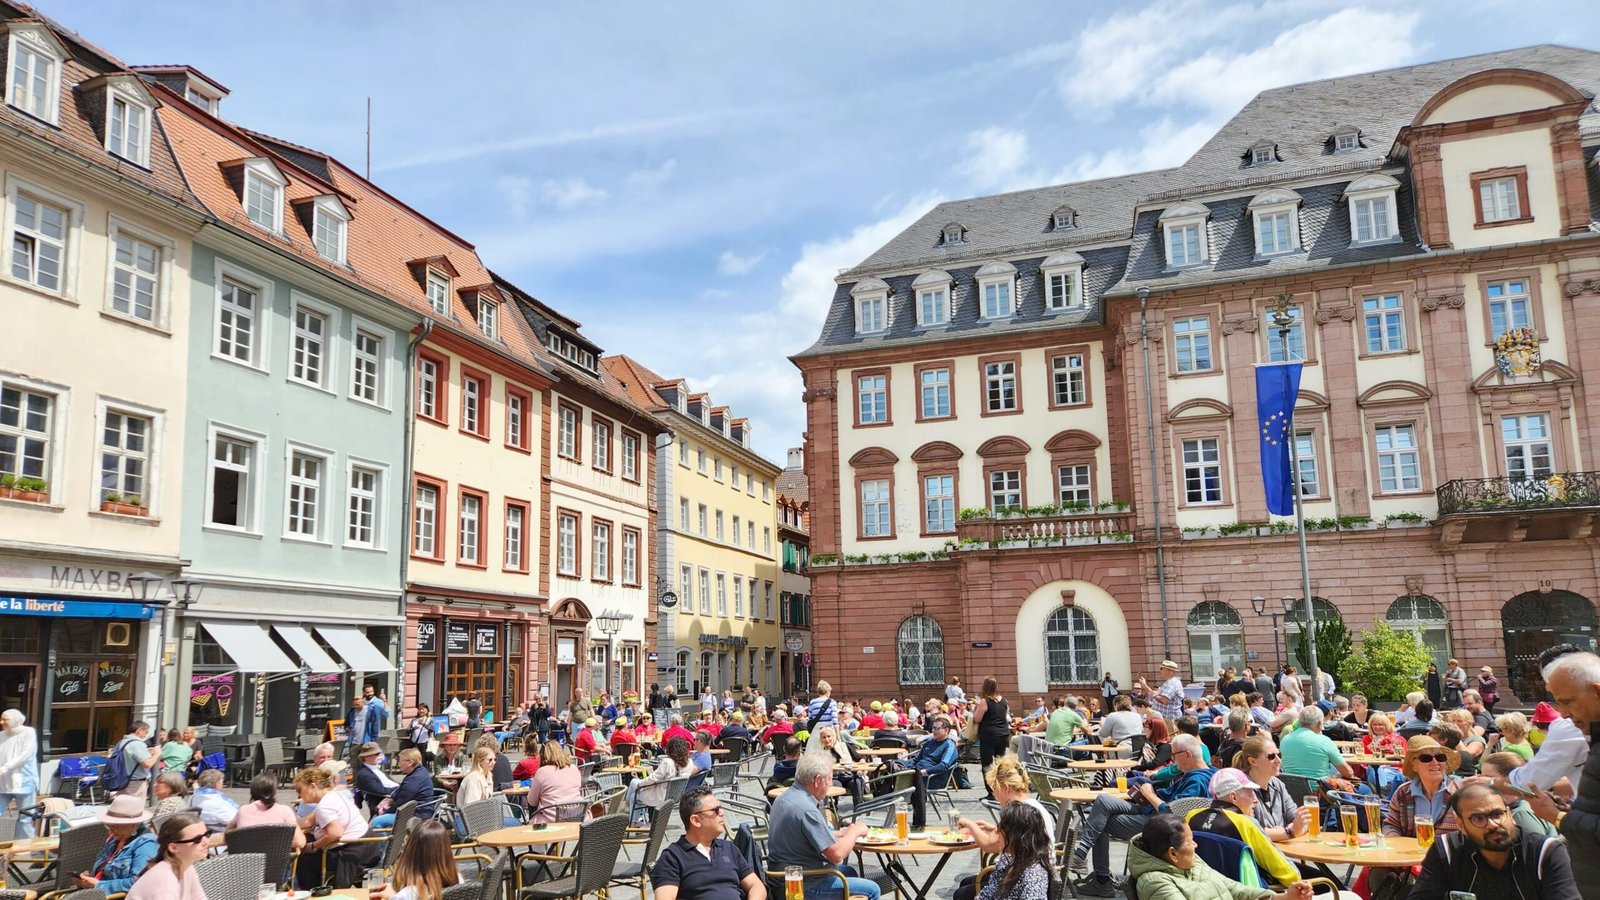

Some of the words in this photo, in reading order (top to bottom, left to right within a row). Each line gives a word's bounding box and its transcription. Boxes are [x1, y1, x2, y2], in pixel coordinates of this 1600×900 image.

[51, 566, 134, 592] MAXBA
[10, 598, 22, 610] la
[25, 599, 65, 612] liberté
[417, 624, 434, 634] ZKB
